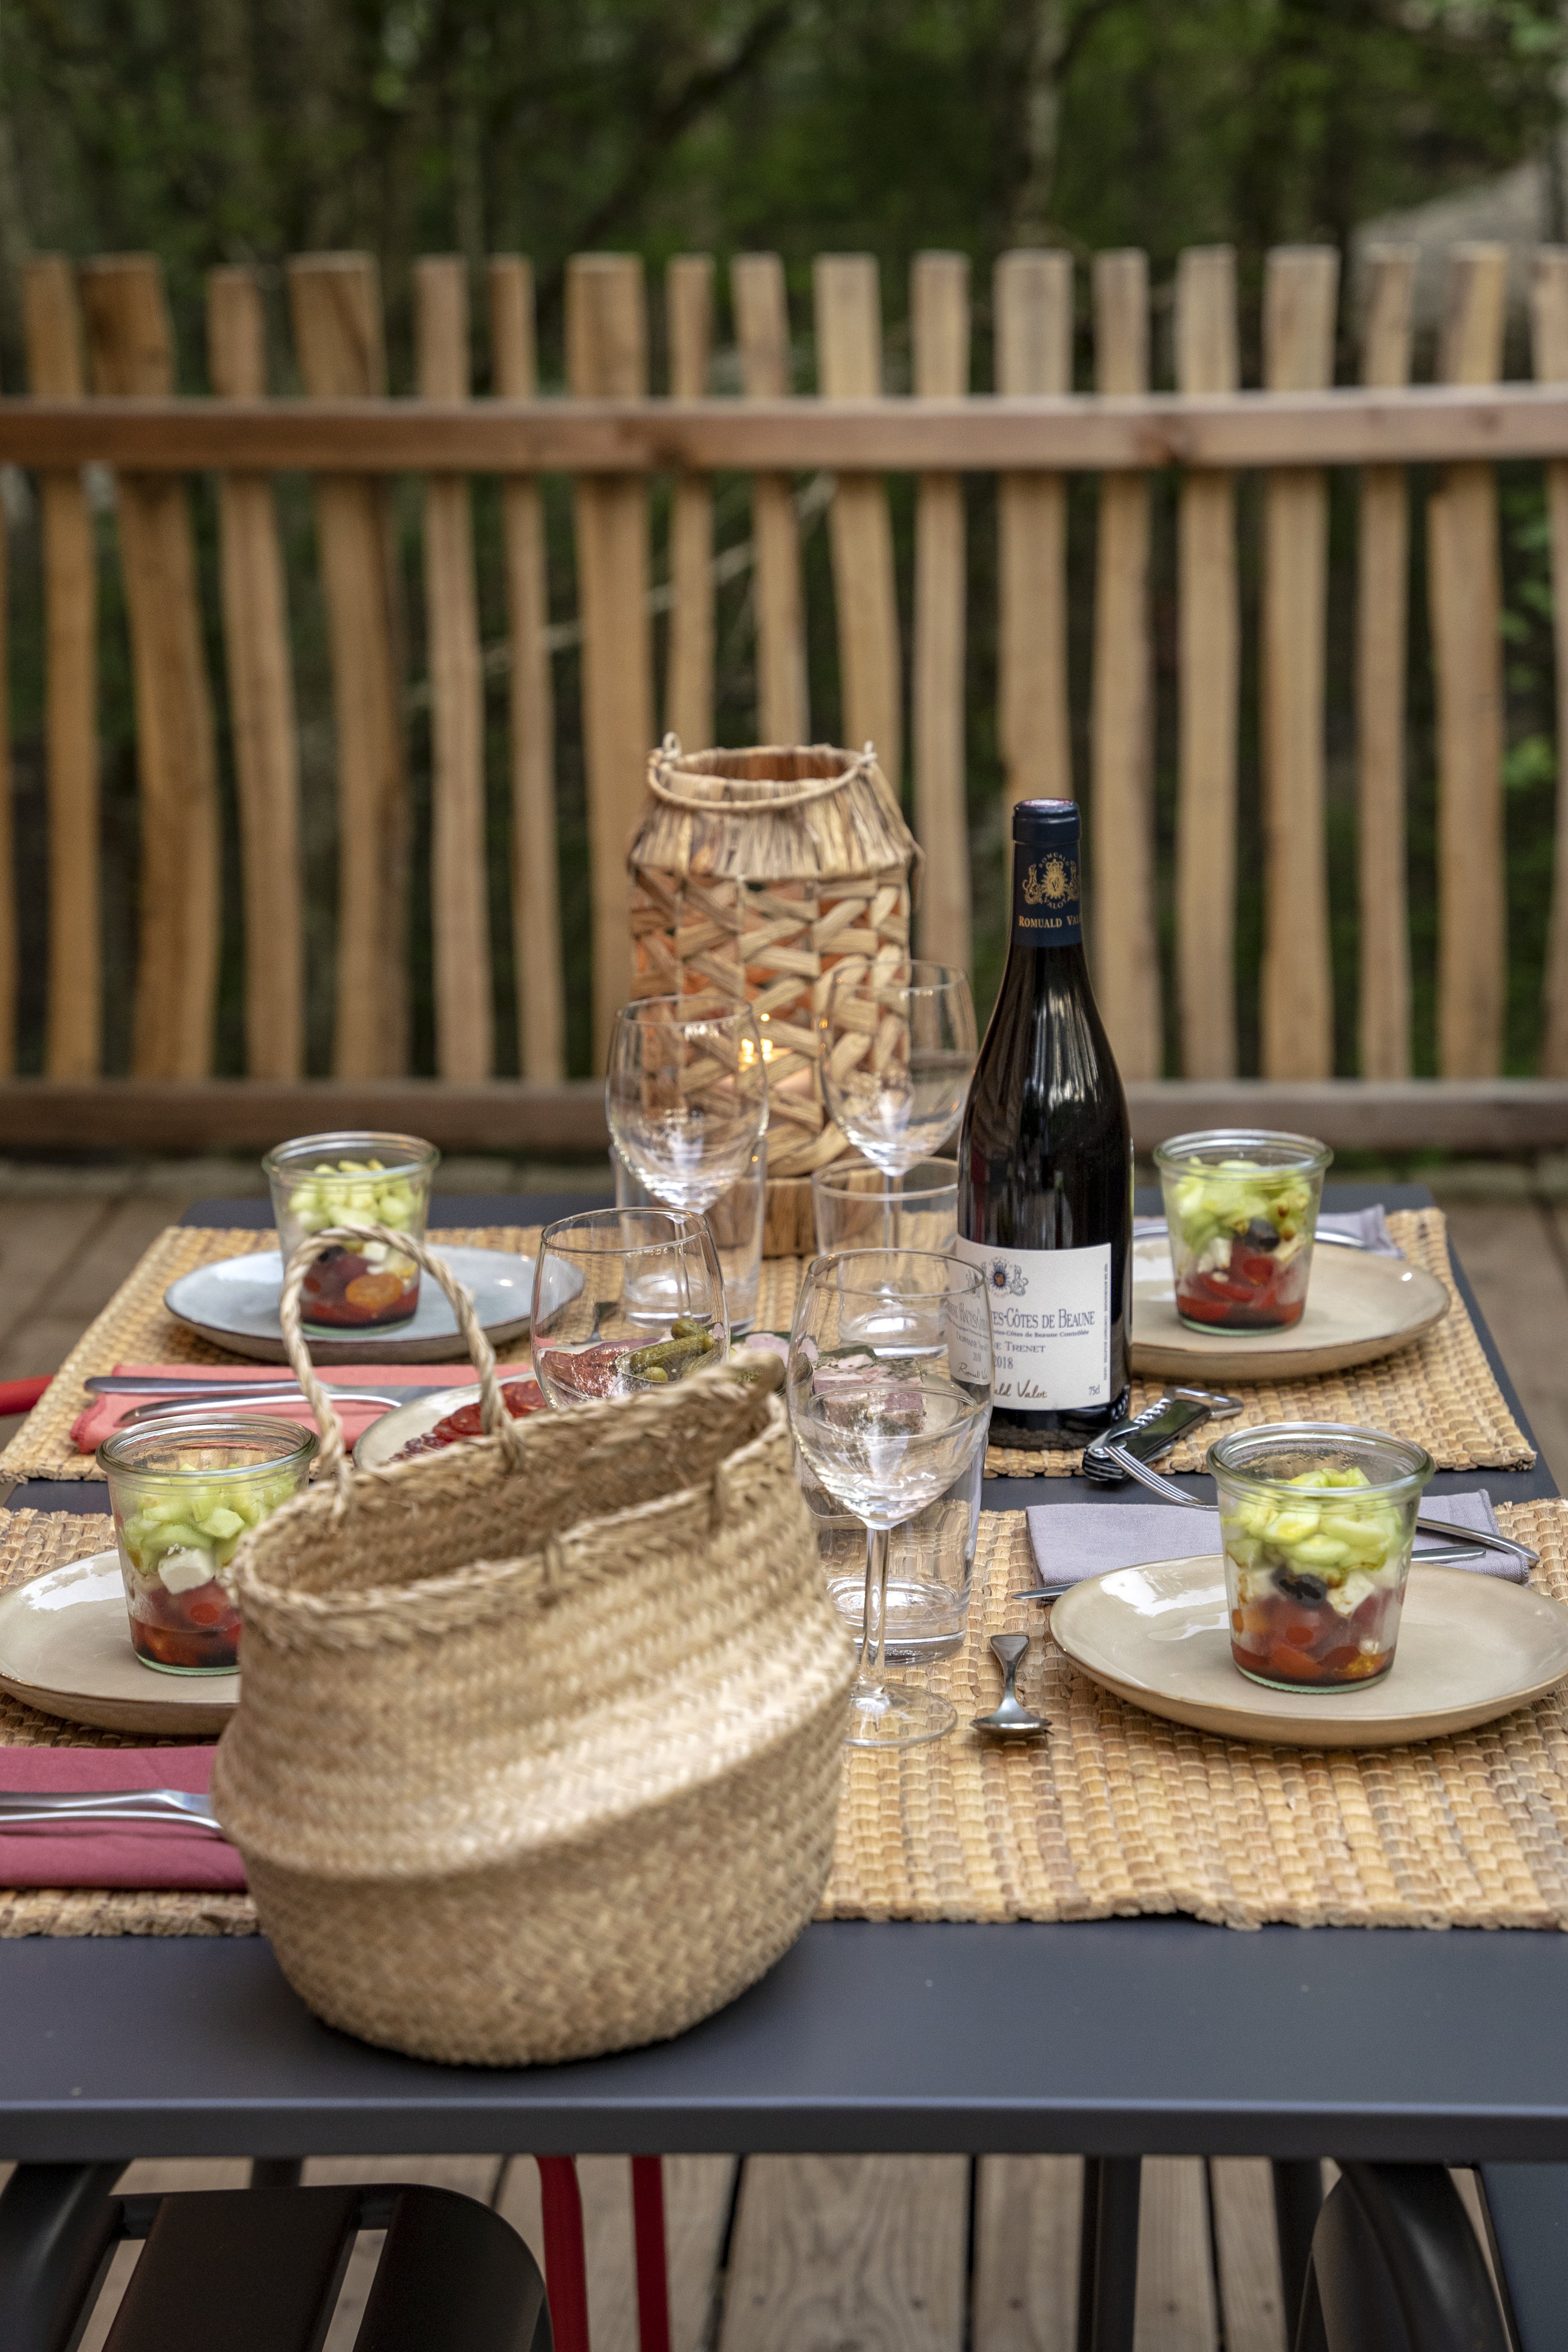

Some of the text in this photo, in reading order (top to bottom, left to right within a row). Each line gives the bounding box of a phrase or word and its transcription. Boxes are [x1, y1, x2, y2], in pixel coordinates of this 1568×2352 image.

[1019, 915, 1062, 928] ROMUALD
[992, 1308, 1039, 1329] TES-CÔTES
[1042, 1314, 1055, 1329] DE
[1059, 1330, 1089, 1338] Contrôlée
[1018, 1379, 1048, 1398] Valot
[1088, 1382, 1101, 1396] 75cl
